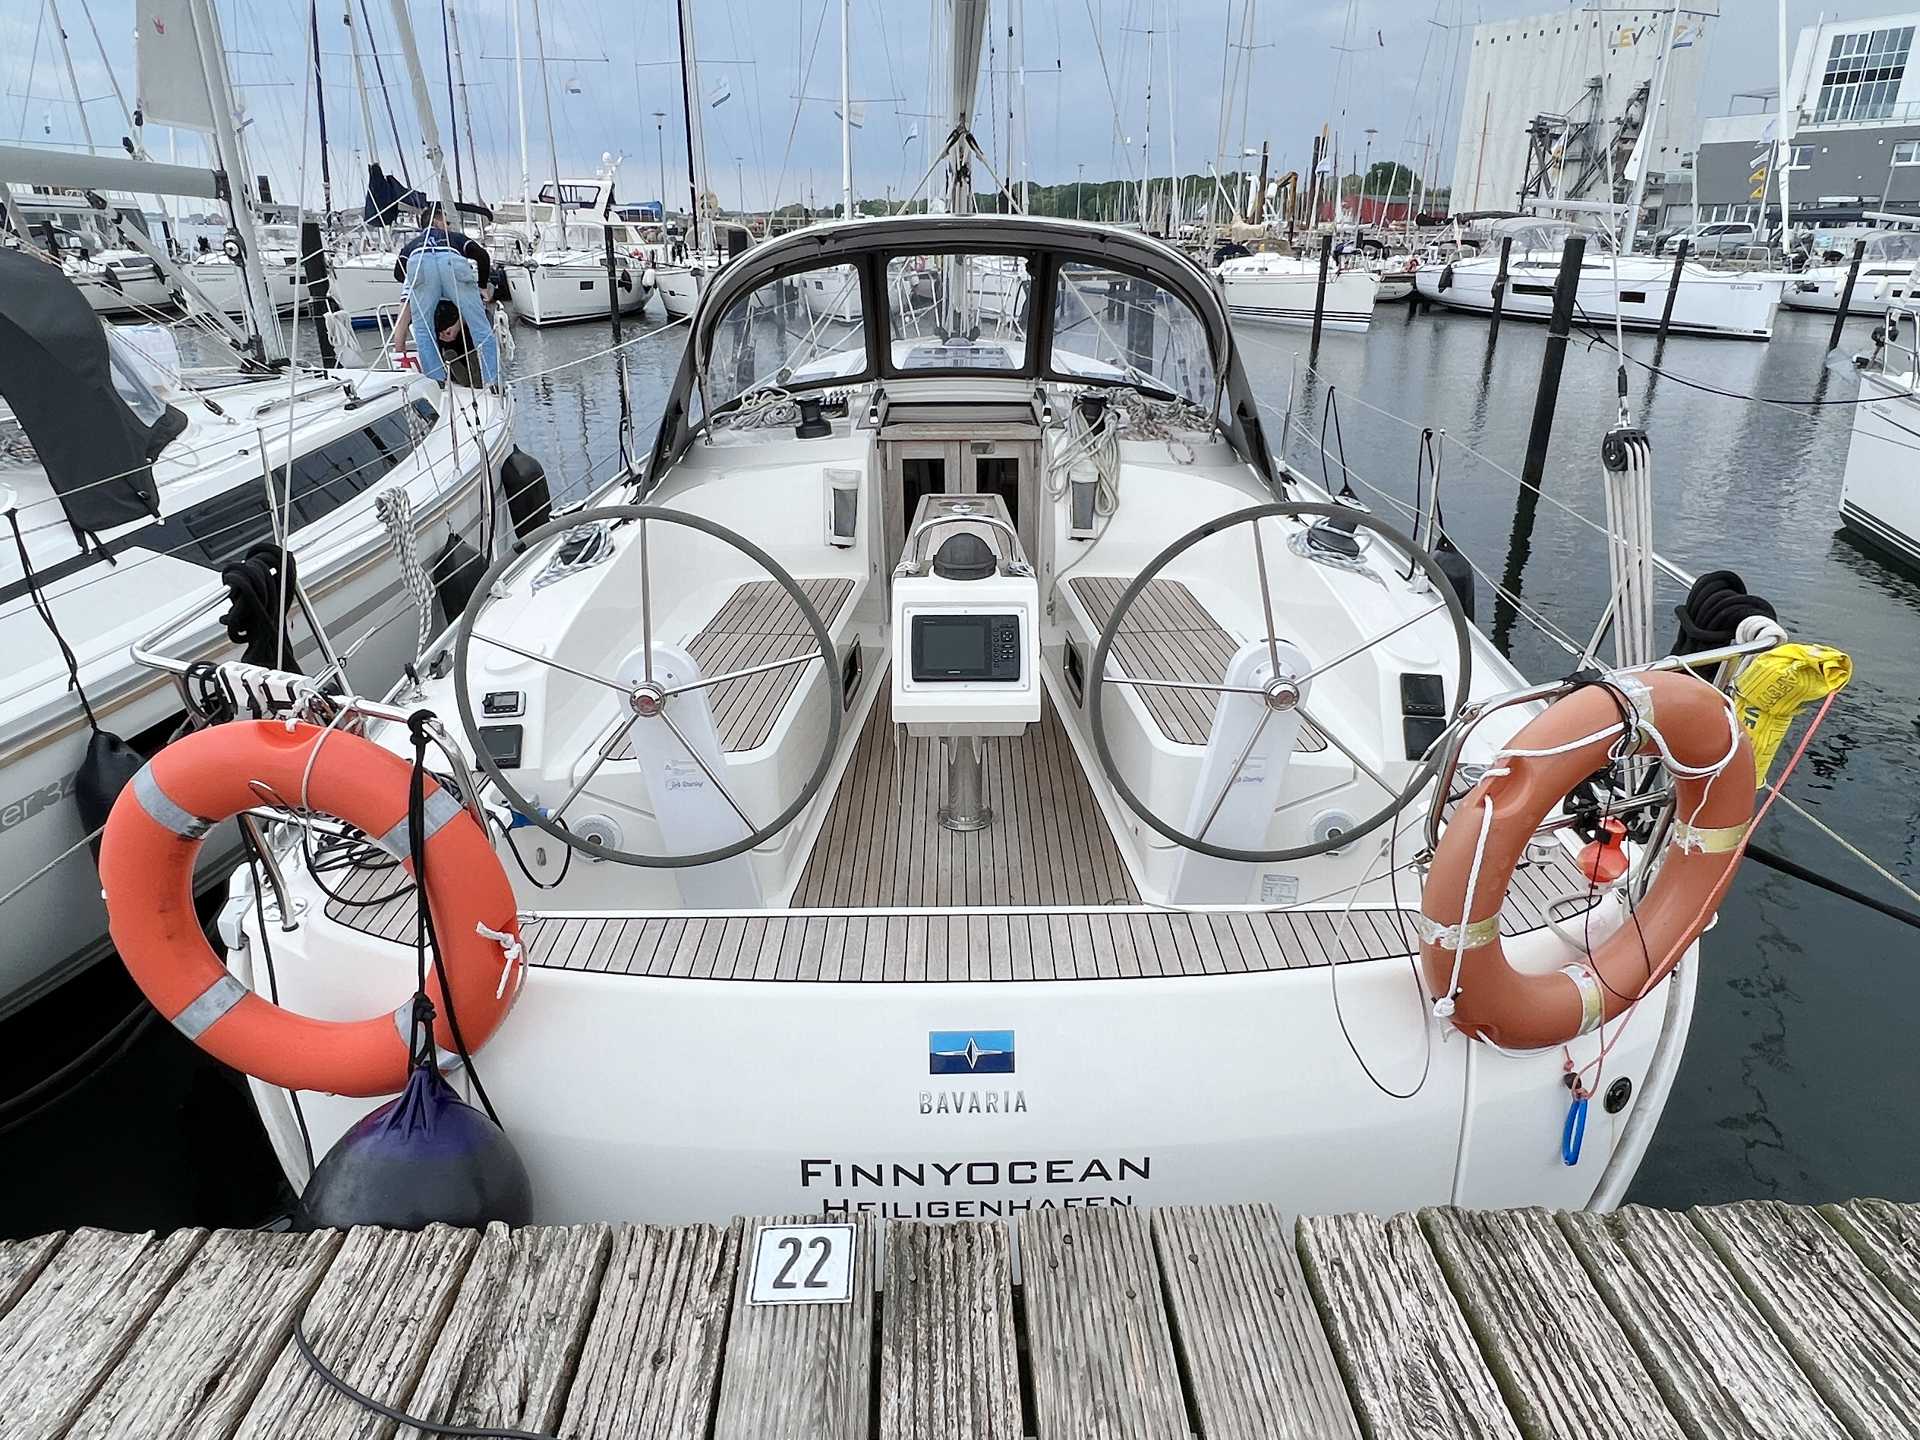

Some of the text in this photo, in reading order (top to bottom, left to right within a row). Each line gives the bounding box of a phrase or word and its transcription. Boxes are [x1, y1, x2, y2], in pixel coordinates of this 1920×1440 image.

[919, 1089, 1028, 1115] BAVARIA
[800, 1156, 1151, 1188] FINNYOCEAN
[773, 1236, 832, 1289] 22
